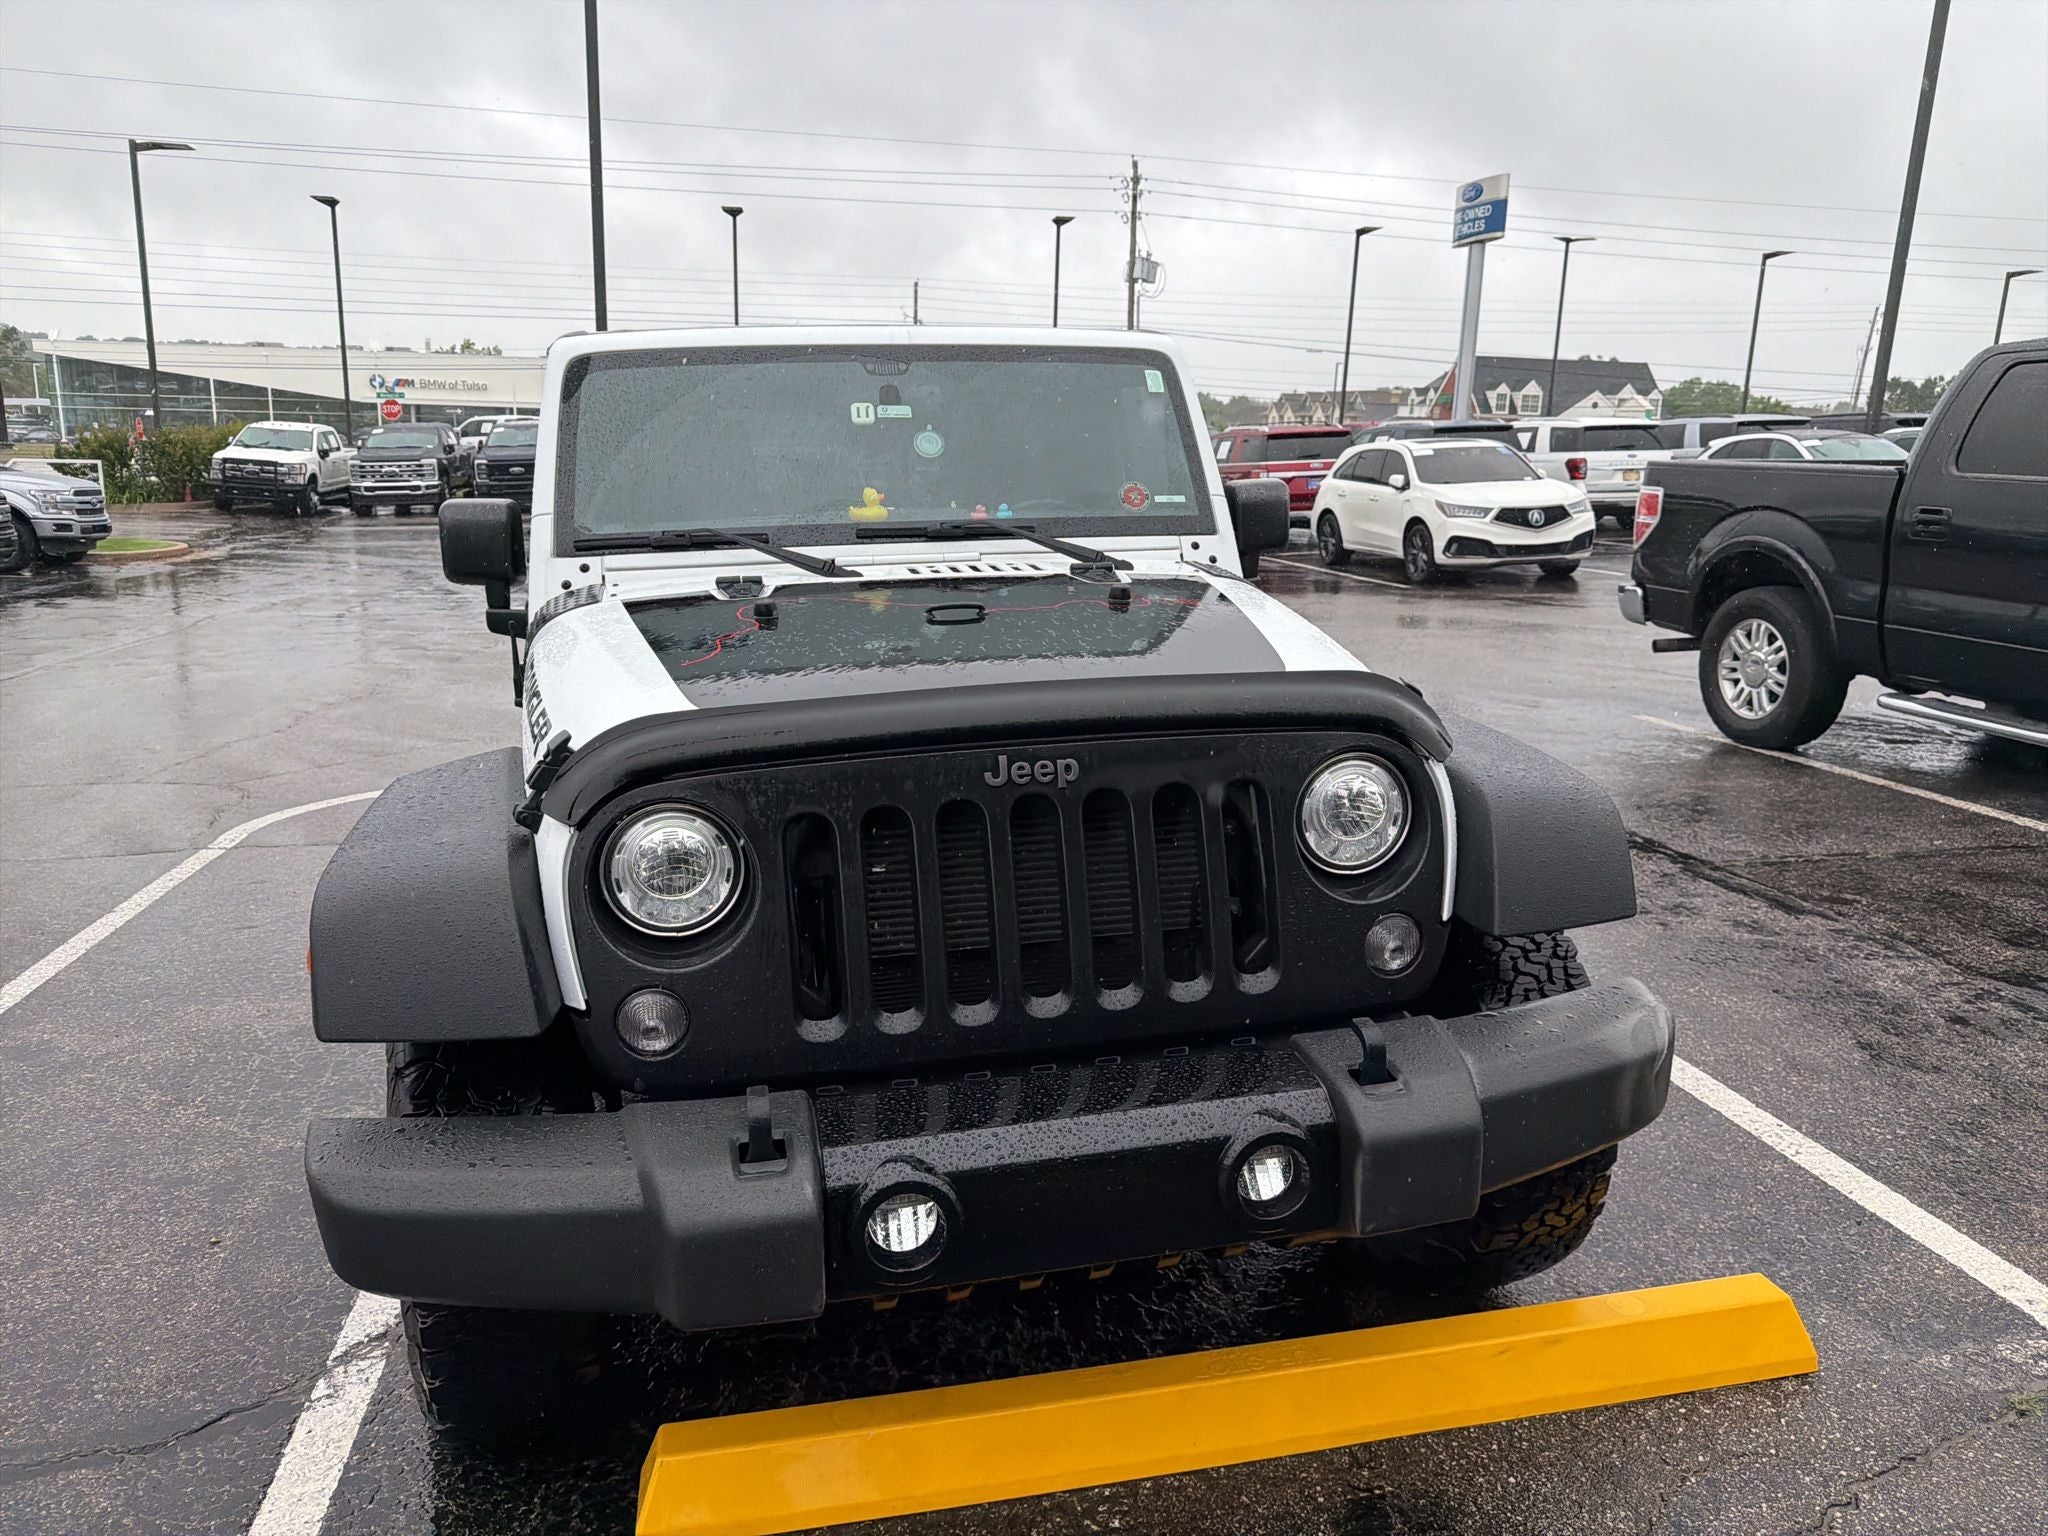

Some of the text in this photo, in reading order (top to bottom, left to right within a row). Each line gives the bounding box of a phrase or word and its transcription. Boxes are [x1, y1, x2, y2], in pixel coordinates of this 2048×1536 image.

[419, 379, 488, 391] BMW of Tulsa
[382, 404, 400, 414] STOP
[983, 754, 1080, 789] Jeep
